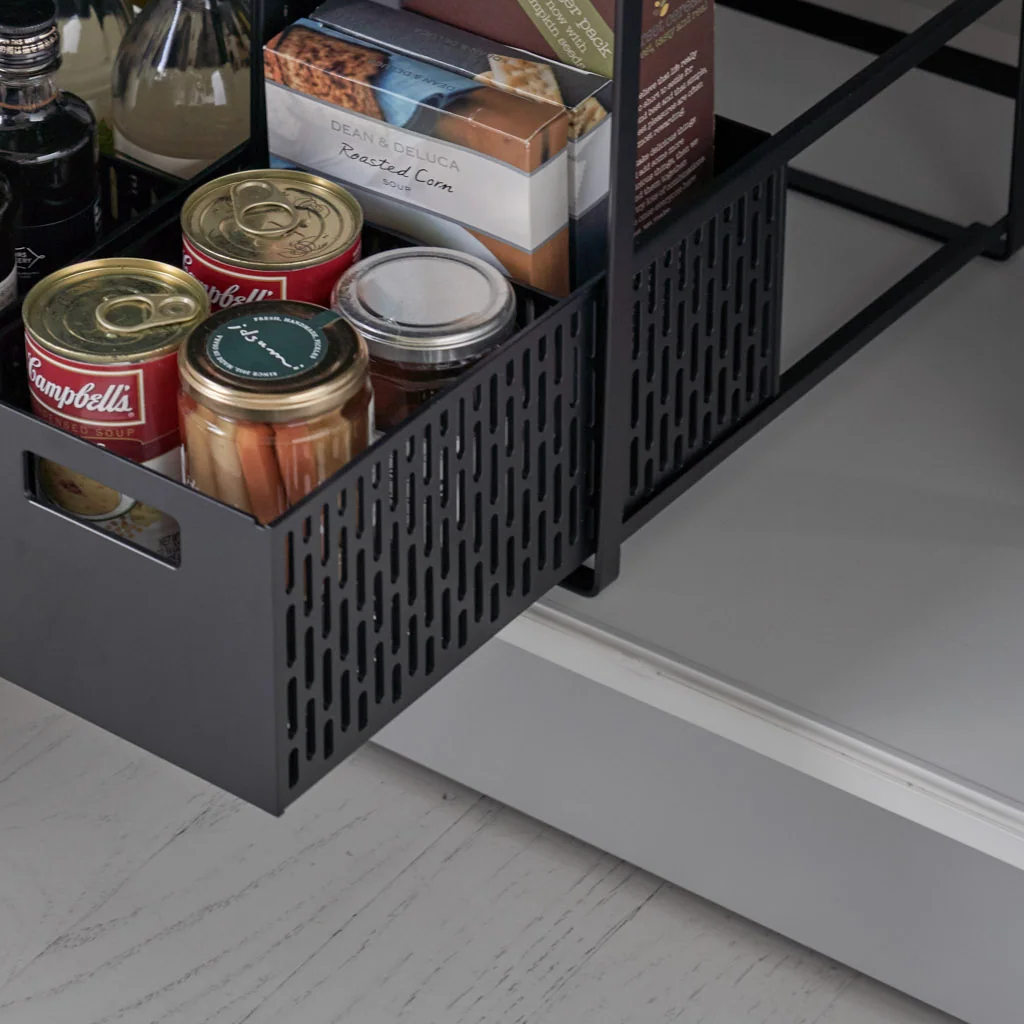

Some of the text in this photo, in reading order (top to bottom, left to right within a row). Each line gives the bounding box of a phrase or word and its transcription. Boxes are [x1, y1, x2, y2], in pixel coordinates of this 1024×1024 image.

[546, 0, 569, 25] now
[565, 25, 588, 54] with
[575, 17, 613, 59] pack
[330, 119, 461, 173] DEAN & DELUCA
[339, 142, 454, 193] Roasted Corn
[382, 178, 412, 192] SOUP
[28, 355, 133, 413] Campbell's
